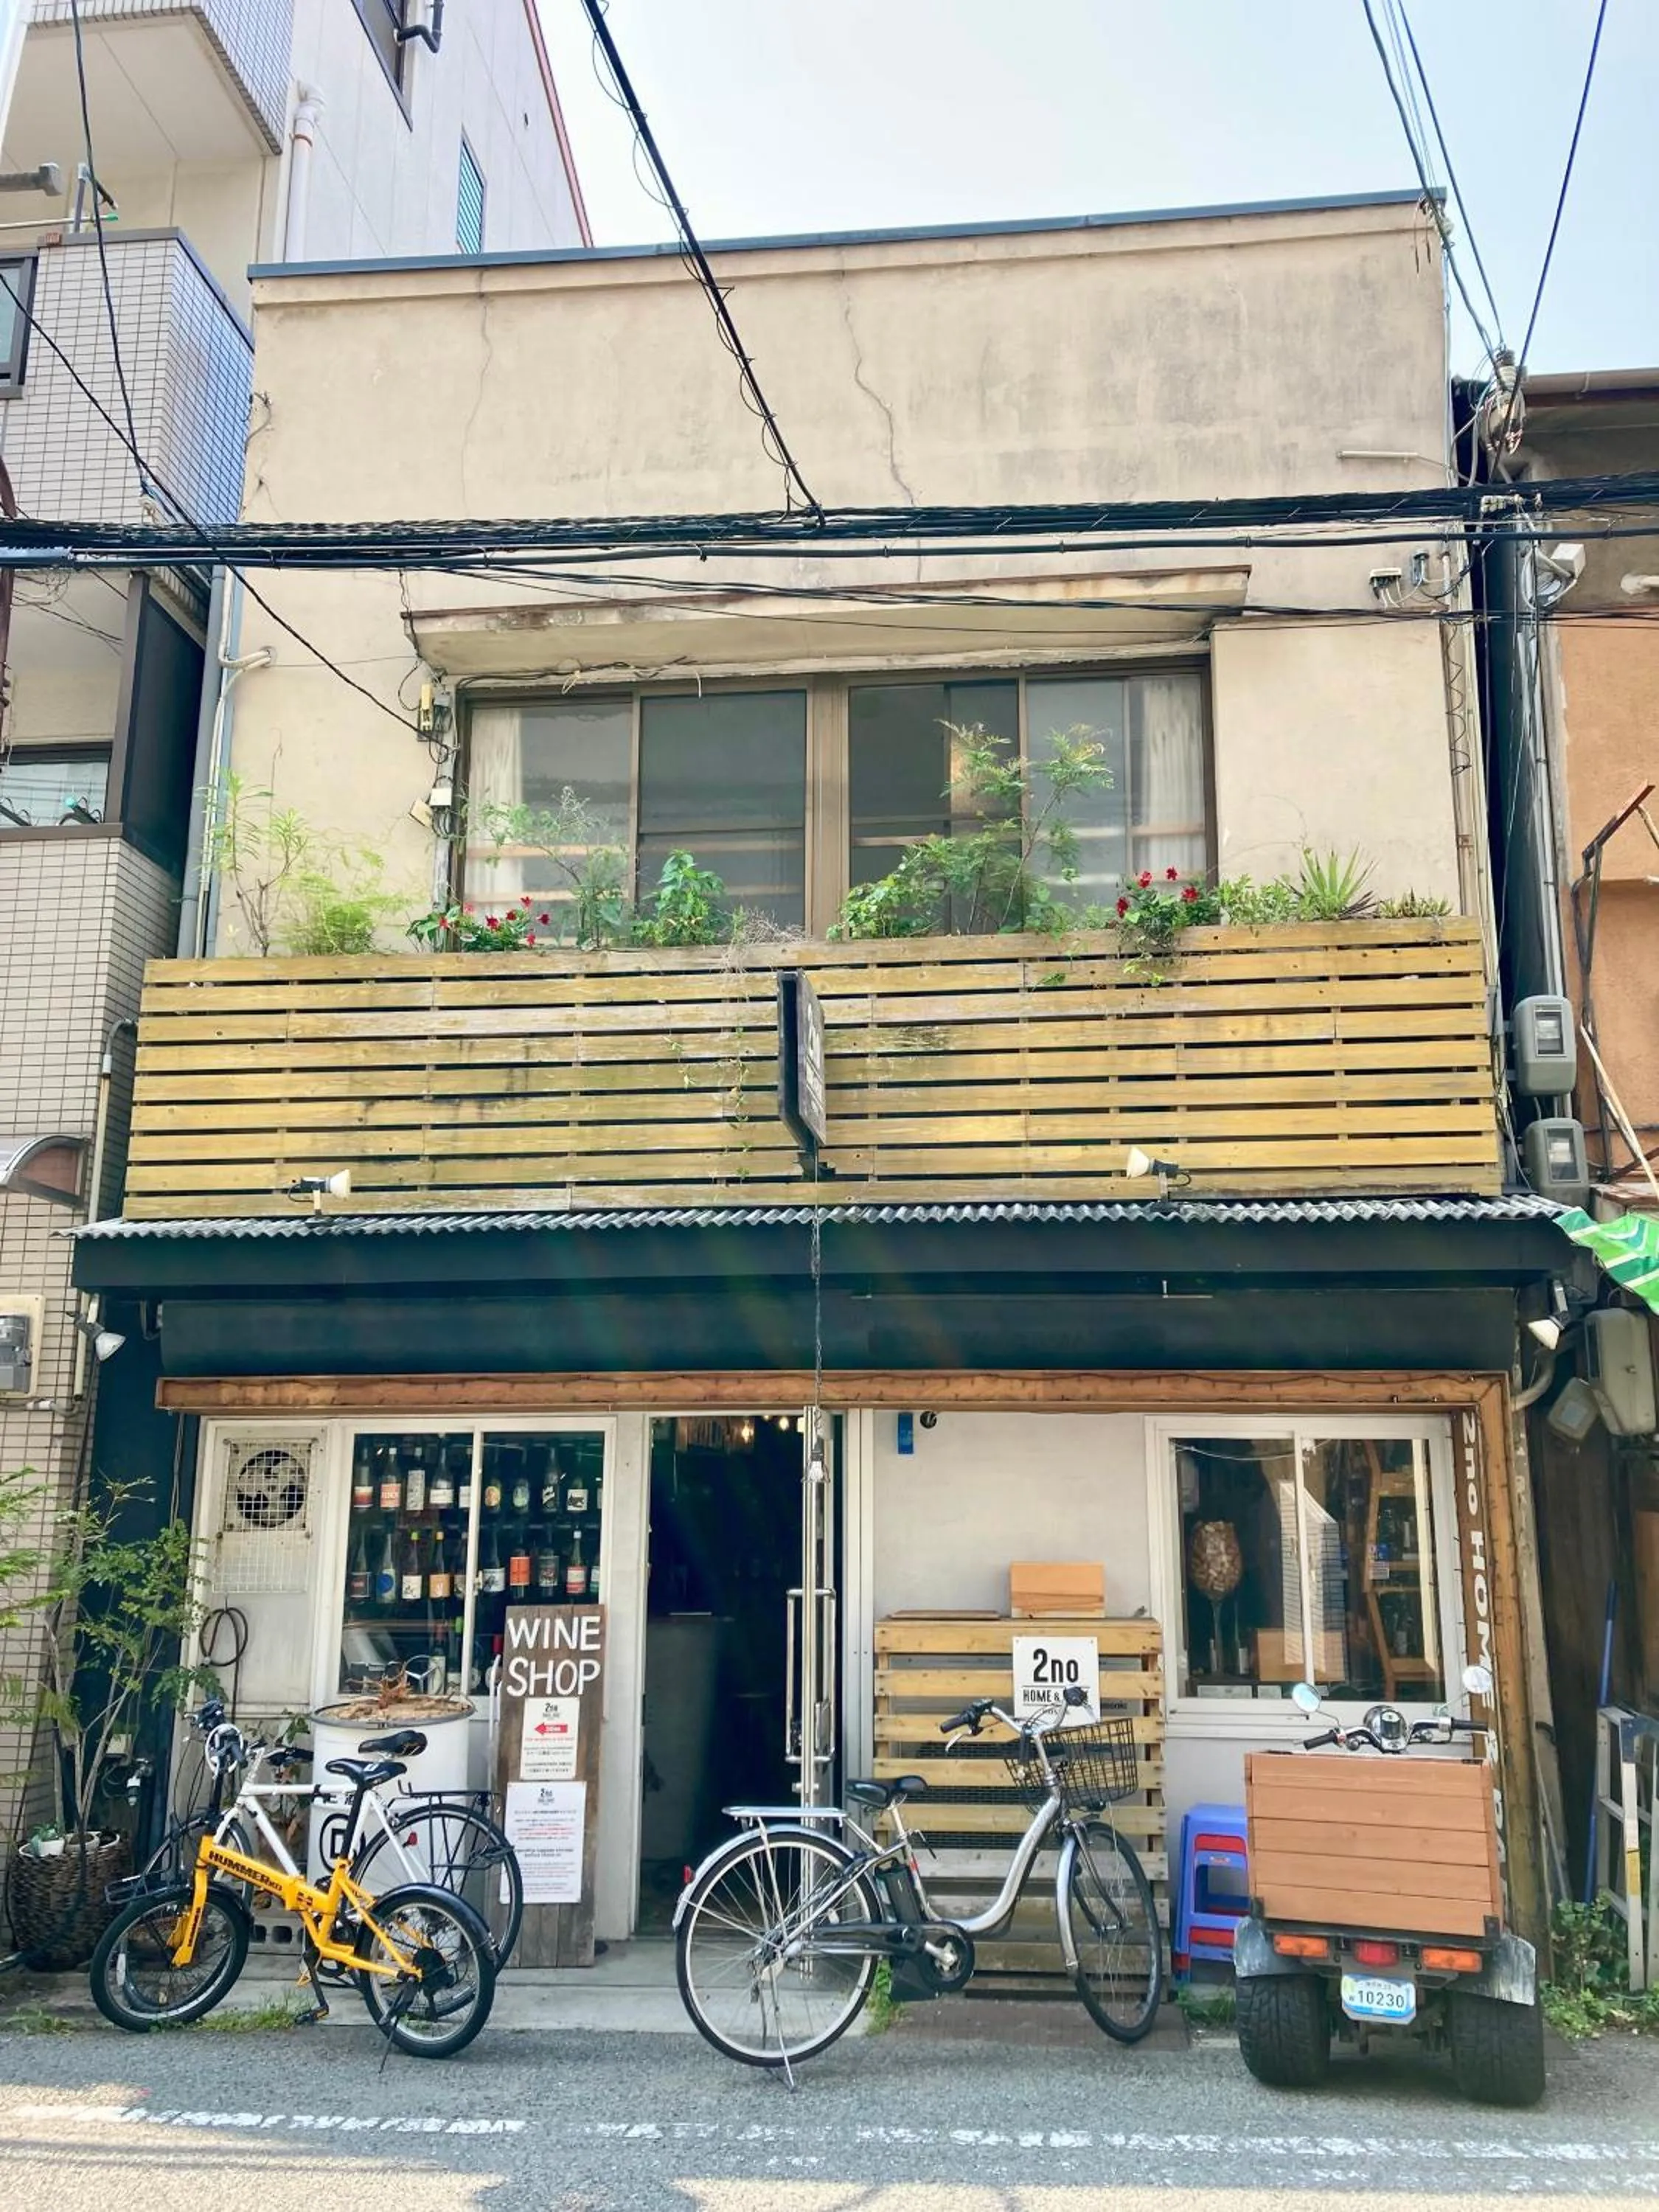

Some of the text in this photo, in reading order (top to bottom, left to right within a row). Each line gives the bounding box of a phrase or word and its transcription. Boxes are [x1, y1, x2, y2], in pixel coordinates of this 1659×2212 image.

[1461, 1411, 1478, 1516] 2no
[507, 1615, 601, 1651] WINE
[506, 1658, 601, 1697] SHOP
[1033, 1648, 1079, 1683] 2no
[1023, 1689, 1060, 1703] HOME &
[209, 1851, 270, 1885] HUMMER
[1357, 1990, 1405, 2008] 10230
